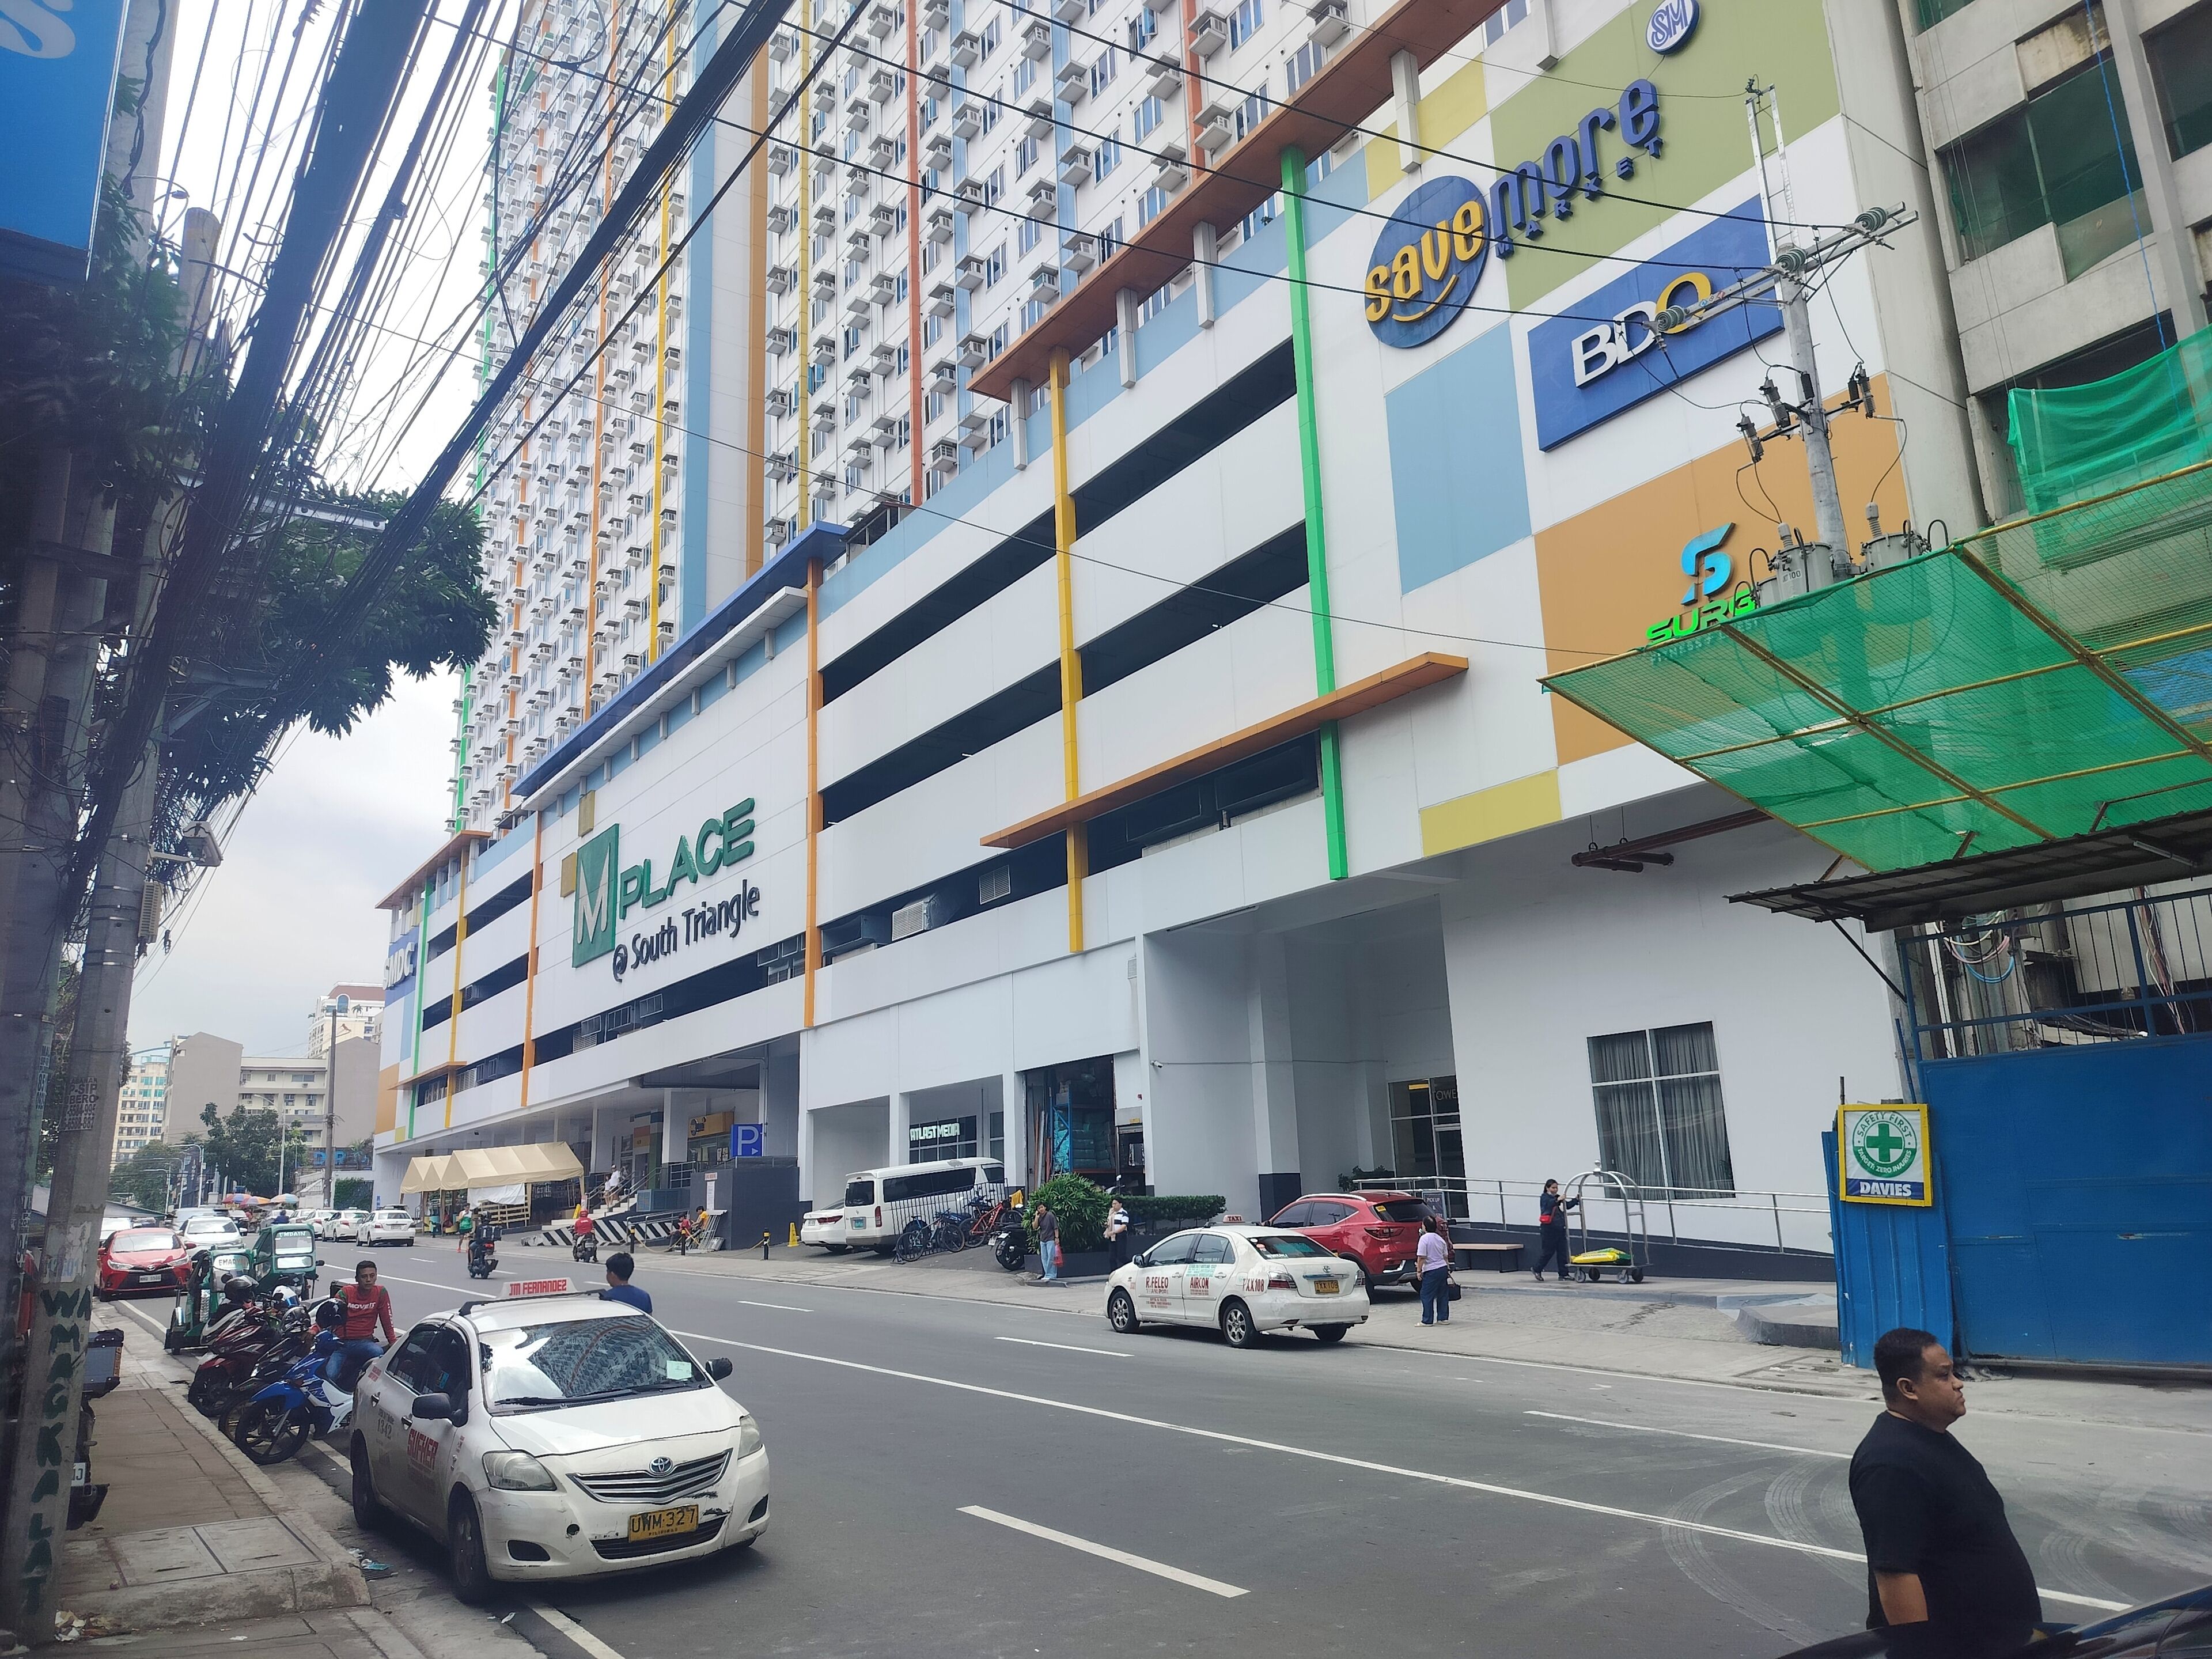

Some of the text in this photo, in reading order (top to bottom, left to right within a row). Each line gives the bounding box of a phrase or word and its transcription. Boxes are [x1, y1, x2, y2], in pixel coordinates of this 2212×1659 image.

[1651, 0, 1689, 44] SM
[1365, 78, 1661, 323] save more
[1495, 135, 1664, 260] MARKET
[1570, 272, 1712, 389] BDO
[620, 797, 755, 921] PLACE
[613, 879, 760, 983] @ South Triangle
[382, 942, 415, 990] SMDC
[737, 1126, 759, 1156] P
[1857, 1112, 1912, 1138] SAFETY FIRST
[1876, 1165, 1893, 1174] ZERO
[1892, 1150, 1912, 1172] INJURIES
[1859, 1181, 1912, 1196] DAVIES
[509, 1279, 567, 1296] JM FERNANDEZ
[1190, 1277, 1209, 1289] AIRCON
[377, 1419, 392, 1440] 1342
